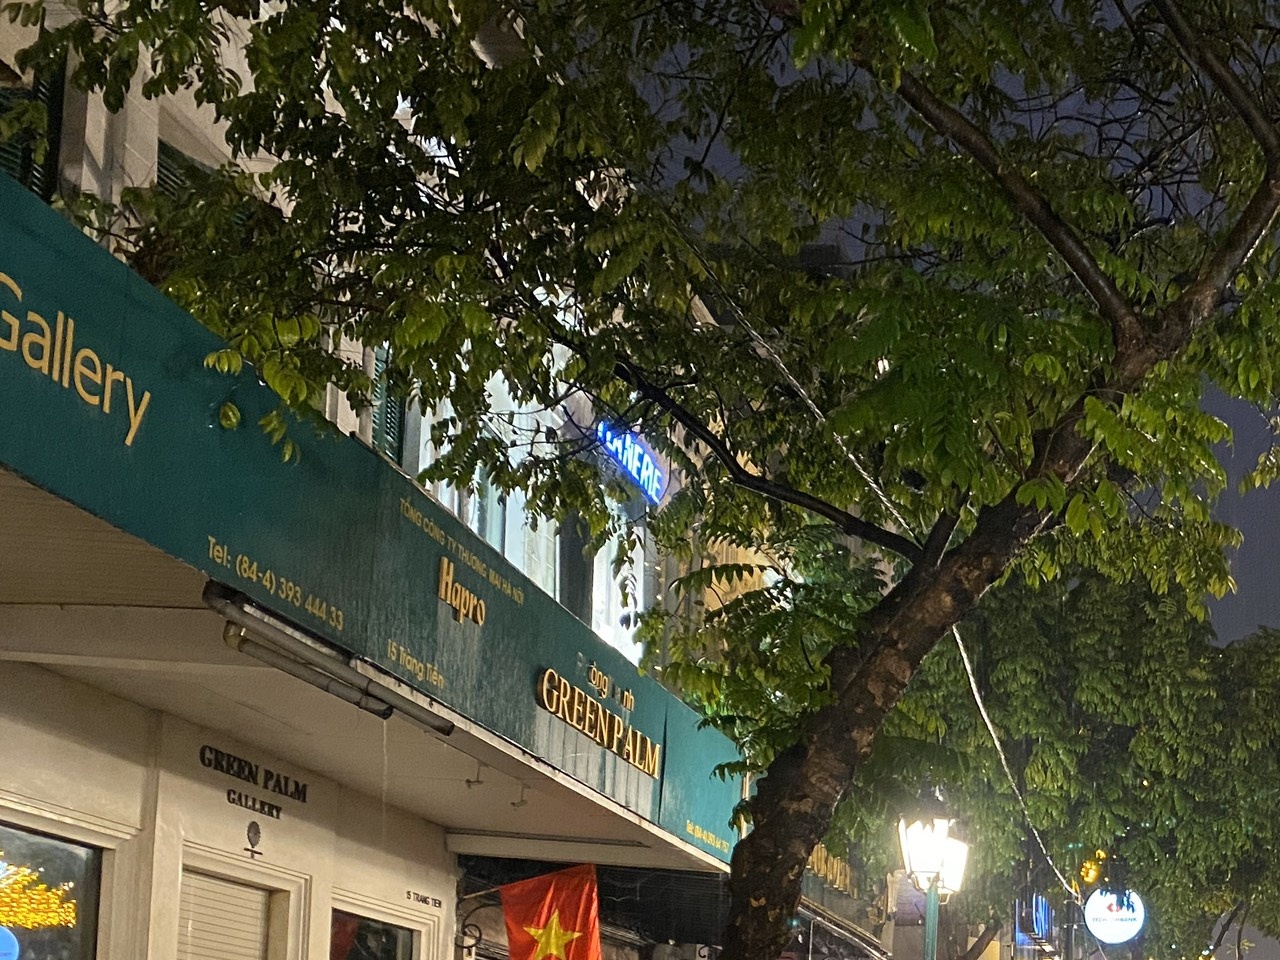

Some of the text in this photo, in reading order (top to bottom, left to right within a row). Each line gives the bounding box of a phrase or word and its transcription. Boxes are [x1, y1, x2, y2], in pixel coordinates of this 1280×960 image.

[208, 535, 344, 631] Tel: (84-4) 393 444 33
[438, 556, 486, 626] Hapro
[387, 638, 397, 660] 15
[542, 668, 660, 780] GREEN PALM
[200, 745, 307, 804] GREEN PALM
[227, 788, 282, 820] GALLERY
